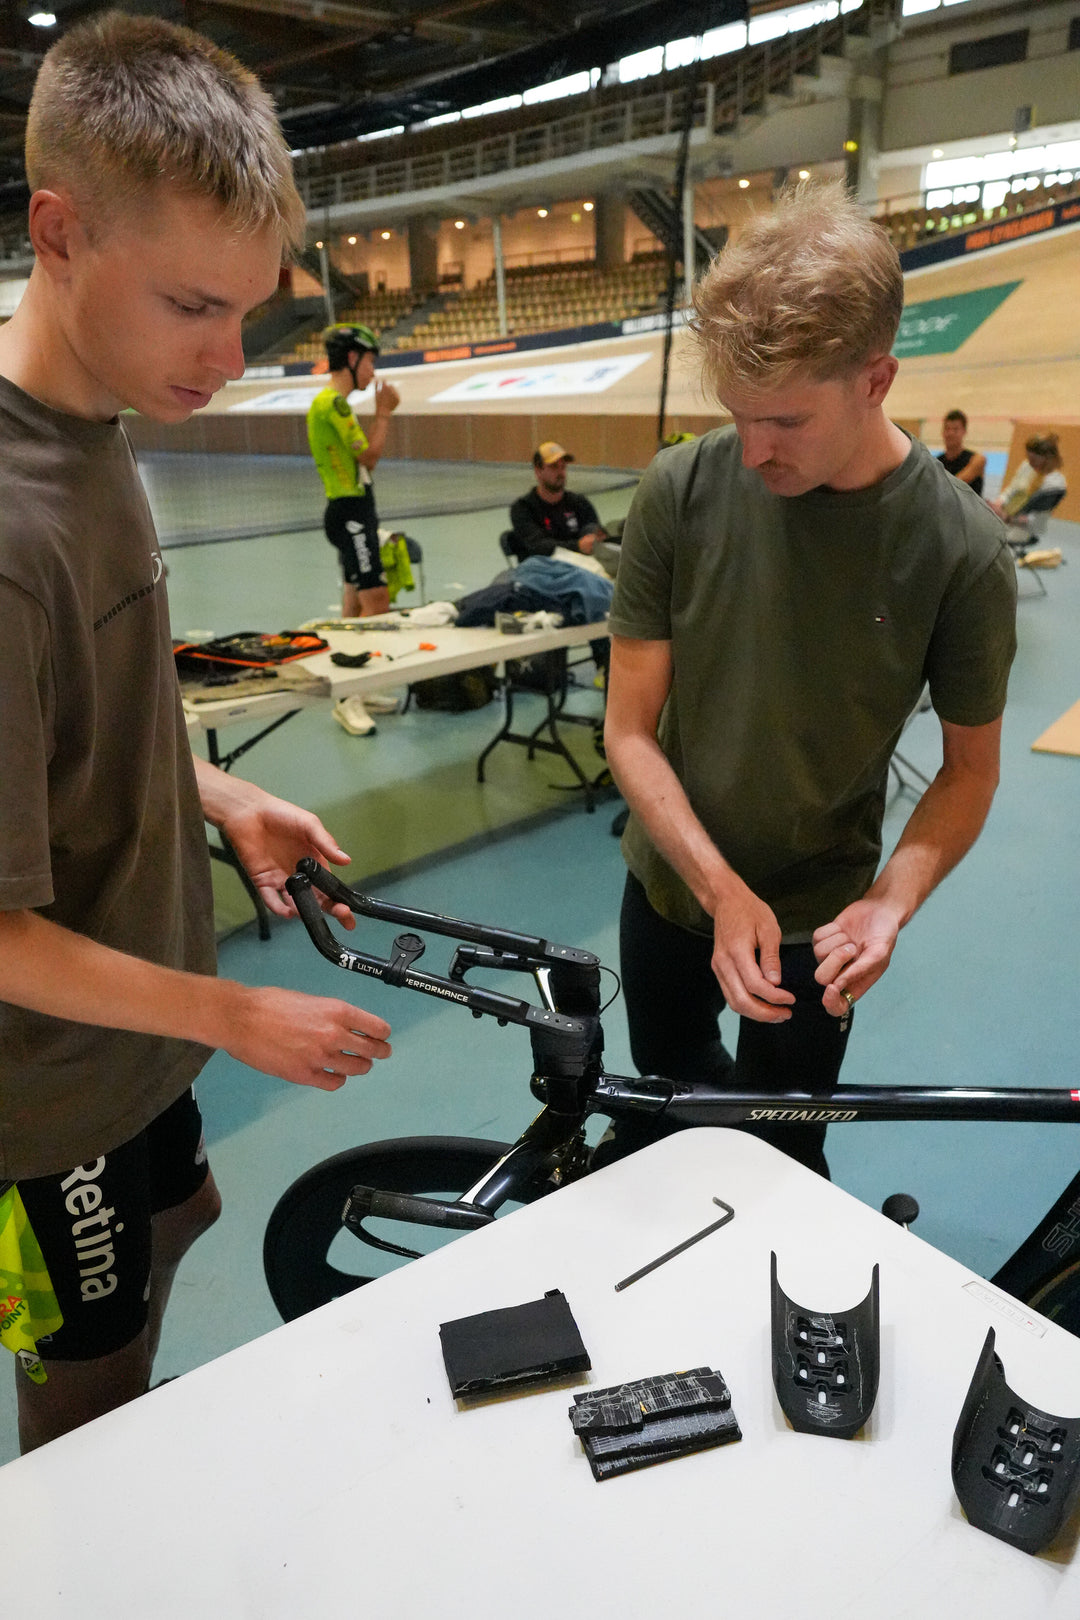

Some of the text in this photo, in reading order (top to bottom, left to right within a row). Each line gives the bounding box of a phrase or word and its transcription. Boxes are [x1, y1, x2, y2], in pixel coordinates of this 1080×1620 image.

[339, 953, 357, 970] 3T
[356, 962, 383, 976] ULTIM
[745, 1109, 858, 1121] SPECIALIZED
[60, 1155, 125, 1302] Retina
[0, 1295, 22, 1322] RA
[0, 1301, 26, 1337] OINT
